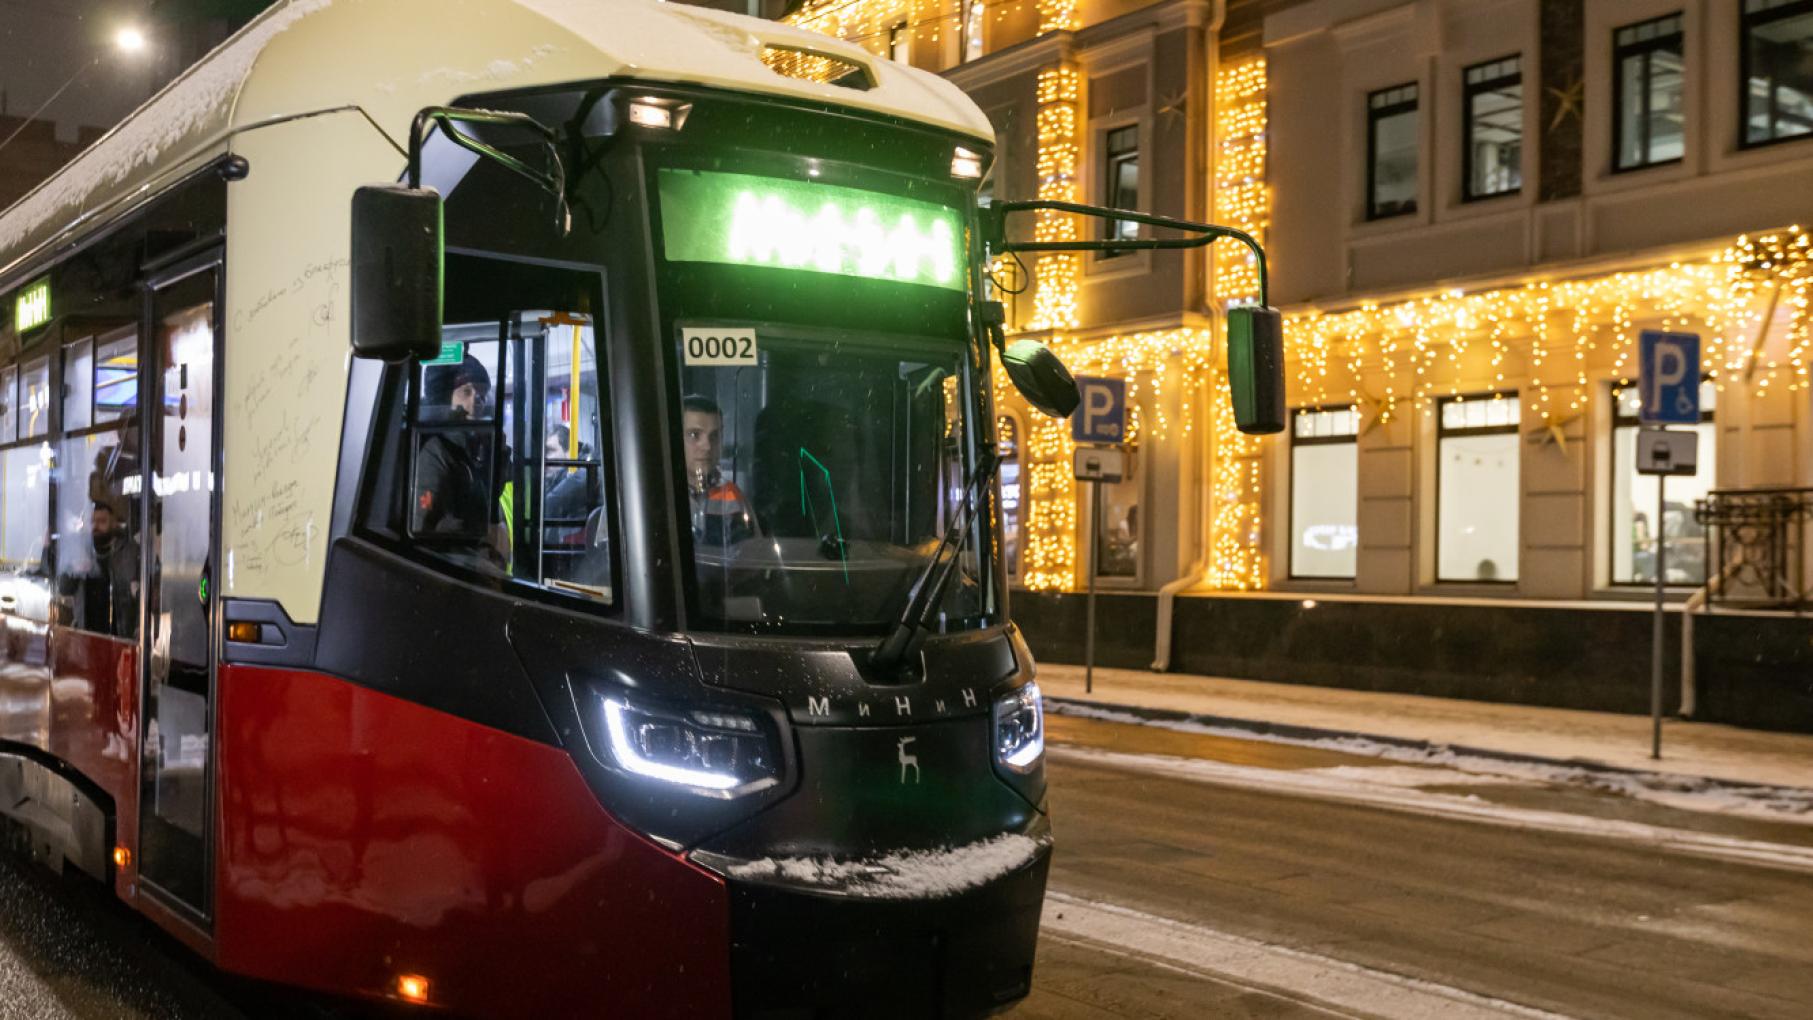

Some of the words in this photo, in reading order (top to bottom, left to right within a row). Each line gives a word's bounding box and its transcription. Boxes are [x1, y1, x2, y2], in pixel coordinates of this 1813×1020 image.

[688, 336, 754, 359] 0002
[1651, 341, 1687, 413] P
[1083, 384, 1114, 435] P
